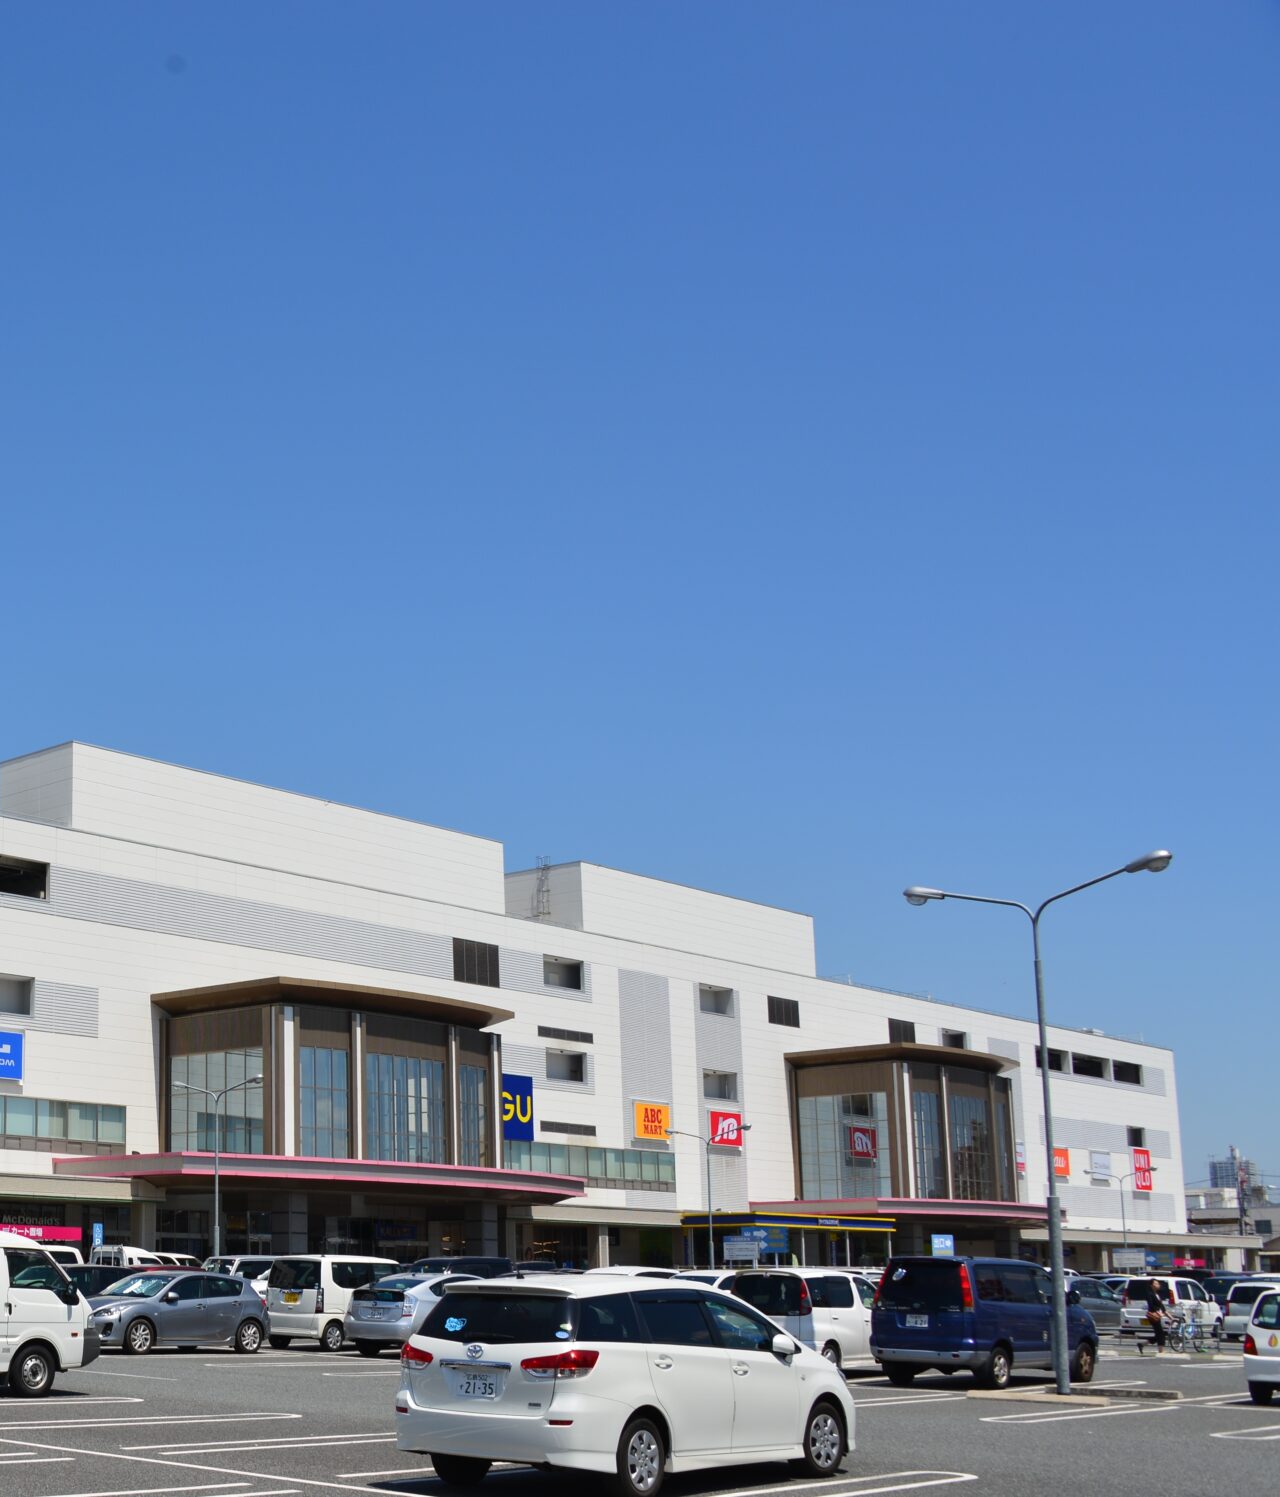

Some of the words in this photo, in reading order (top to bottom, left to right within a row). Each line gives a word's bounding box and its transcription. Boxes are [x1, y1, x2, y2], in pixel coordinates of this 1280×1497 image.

[643, 1107, 662, 1124] ABC
[643, 1123, 662, 1136] MART
[1135, 1153, 1148, 1168] UNI
[1136, 1171, 1150, 1188] QLO
[2, 1215, 60, 1226] McDonald's
